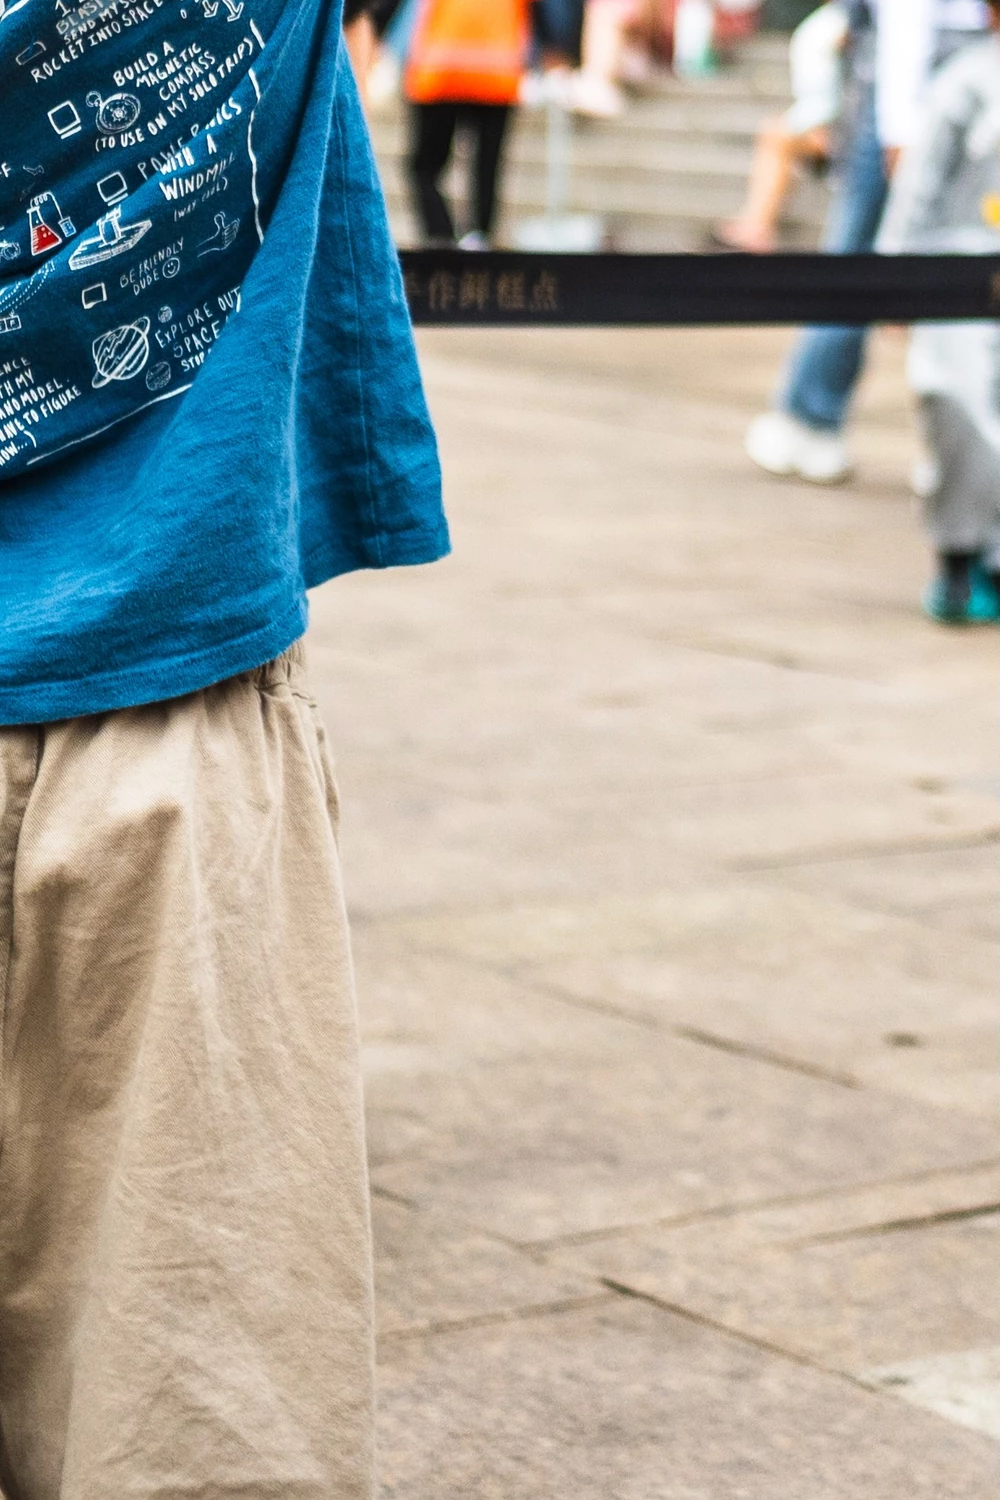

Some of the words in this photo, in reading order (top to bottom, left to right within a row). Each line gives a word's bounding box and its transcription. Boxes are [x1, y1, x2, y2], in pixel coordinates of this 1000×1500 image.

[63, 18, 96, 45] SEND
[99, 5, 120, 23] MY
[31, 39, 84, 83] ROCKET
[88, 23, 121, 47] INTO
[113, 50, 159, 87] BUILD
[163, 41, 174, 58] A
[136, 42, 202, 88] MAGNETIC
[120, 127, 145, 148] USE
[149, 113, 168, 136] ON
[167, 93, 188, 118] MY
[189, 76, 218, 102] SOLO
[216, 37, 254, 79] TRIP)
[159, 51, 216, 101] COMPASS
[159, 146, 195, 176] WITH
[206, 133, 217, 155] A
[119, 271, 136, 288] BE
[138, 237, 184, 279] FRIENDLY
[133, 269, 160, 296] DUDE
[173, 320, 220, 358] SPACE
[15, 368, 35, 389] MY
[20, 378, 63, 408] MODEL
[23, 408, 40, 426] TO
[40, 384, 82, 418] FIGURE
